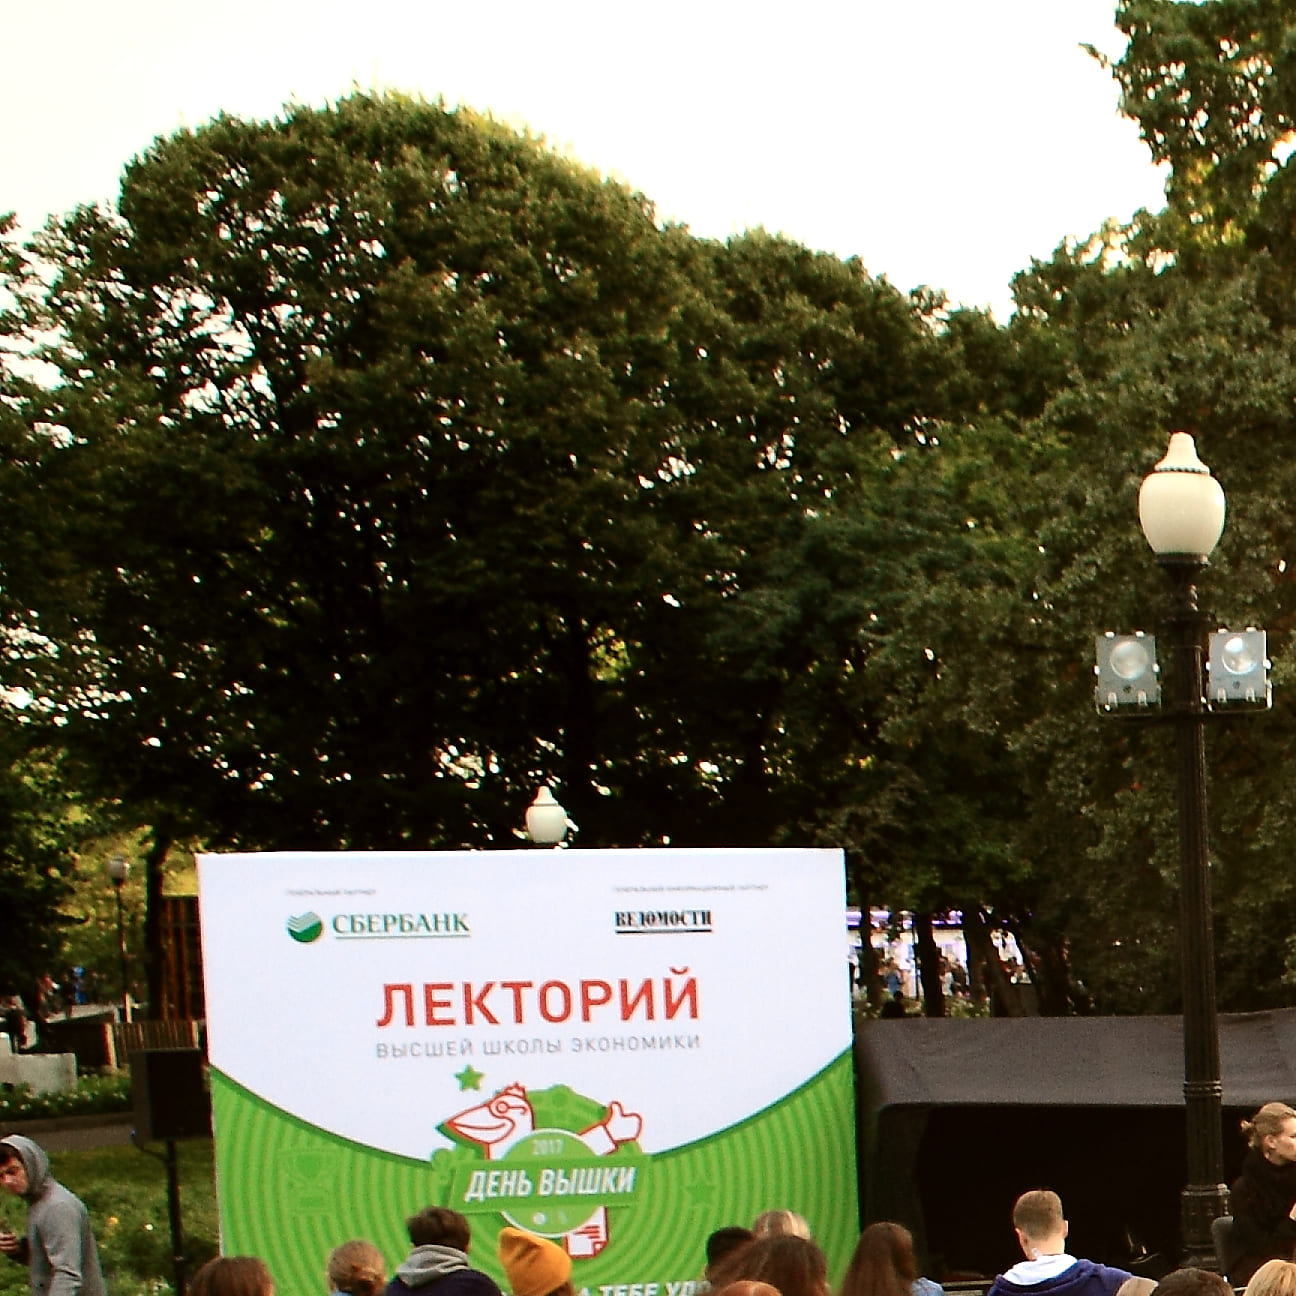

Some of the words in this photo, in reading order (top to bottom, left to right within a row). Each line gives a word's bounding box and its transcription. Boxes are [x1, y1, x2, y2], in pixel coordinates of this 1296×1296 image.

[332, 912, 470, 934] СБЕРБАНК
[614, 910, 712, 928] ВЕДОМОСТИ
[376, 966, 698, 1027] ЛЕКТОРИЙ
[376, 1038, 474, 1058] ВЫСШЕЙ
[482, 1038, 562, 1055] ШКОЛЫ
[571, 1033, 700, 1053] ЭКОНОМИКИ
[532, 1138, 565, 1156] 2017
[464, 1169, 533, 1202] ДЕНЬ
[537, 1165, 637, 1197] ВЫШКИ
